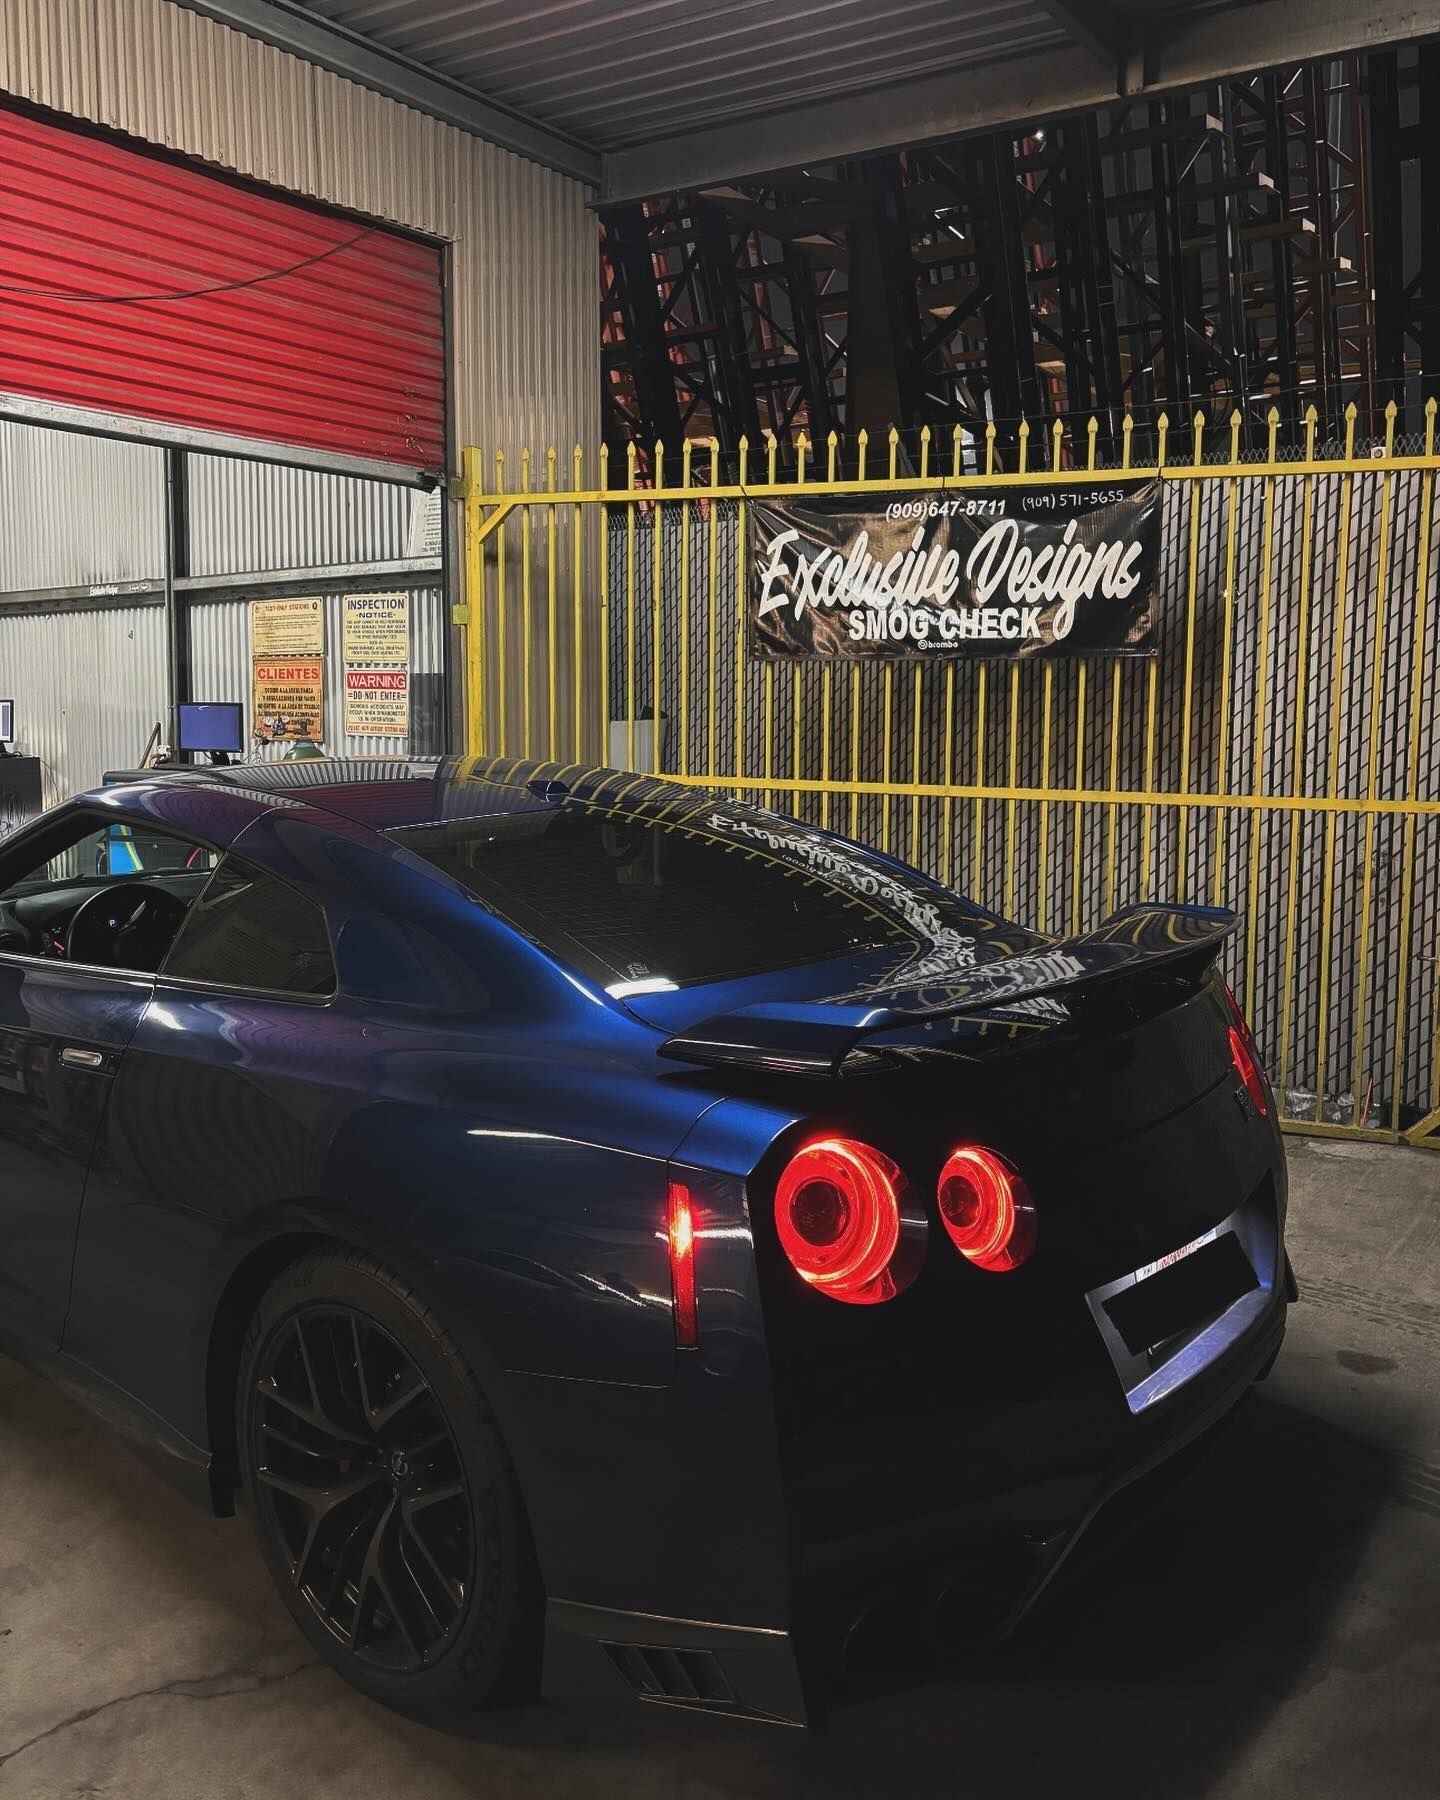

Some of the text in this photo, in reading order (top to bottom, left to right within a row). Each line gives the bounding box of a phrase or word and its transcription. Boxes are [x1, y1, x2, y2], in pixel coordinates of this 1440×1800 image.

[885, 499, 1006, 522] (909)647-8711
[758, 518, 1143, 641] Exclusive Designs
[347, 599, 405, 610] INSPECTION
[848, 606, 1043, 641] SMOG CHECK
[257, 668, 319, 680] CLIENTES
[348, 674, 406, 688] WARNING
[353, 690, 401, 701] DO NOT ENTER
